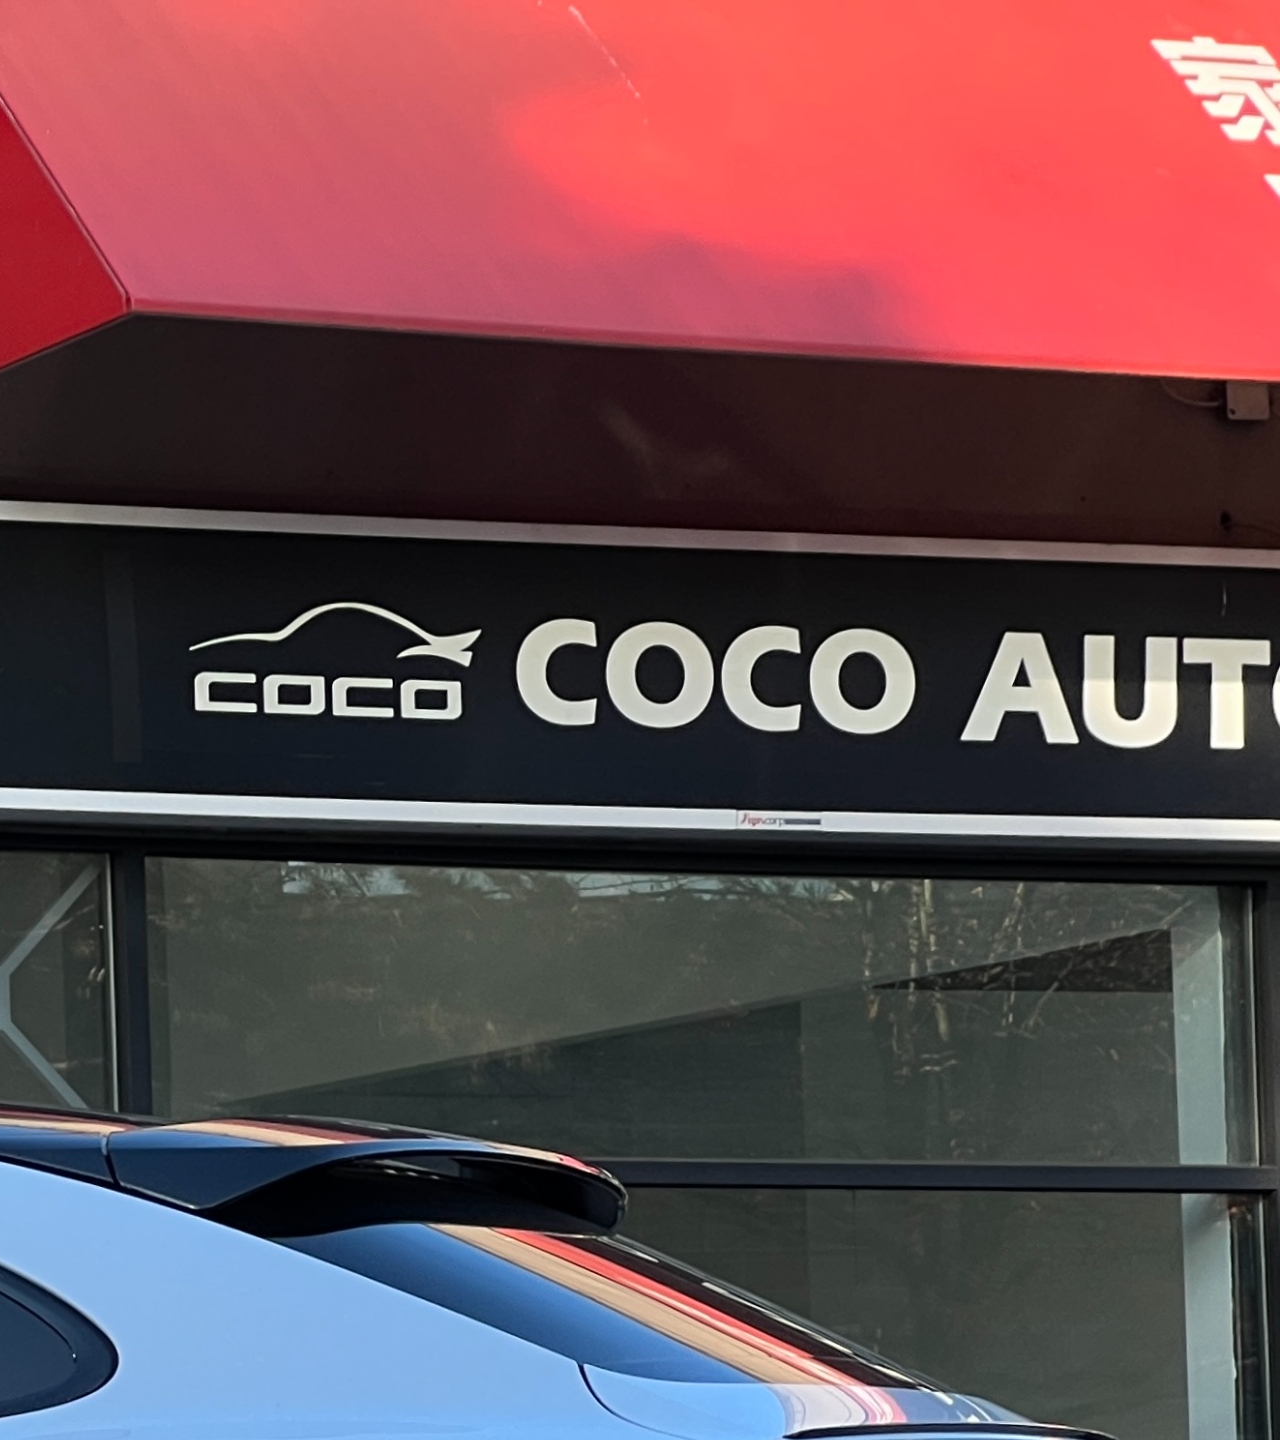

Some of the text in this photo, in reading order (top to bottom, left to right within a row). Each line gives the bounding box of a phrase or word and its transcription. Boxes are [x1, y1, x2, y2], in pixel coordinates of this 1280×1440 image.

[193, 671, 463, 720] COCO
[515, 618, 1280, 750] COCO AUT
